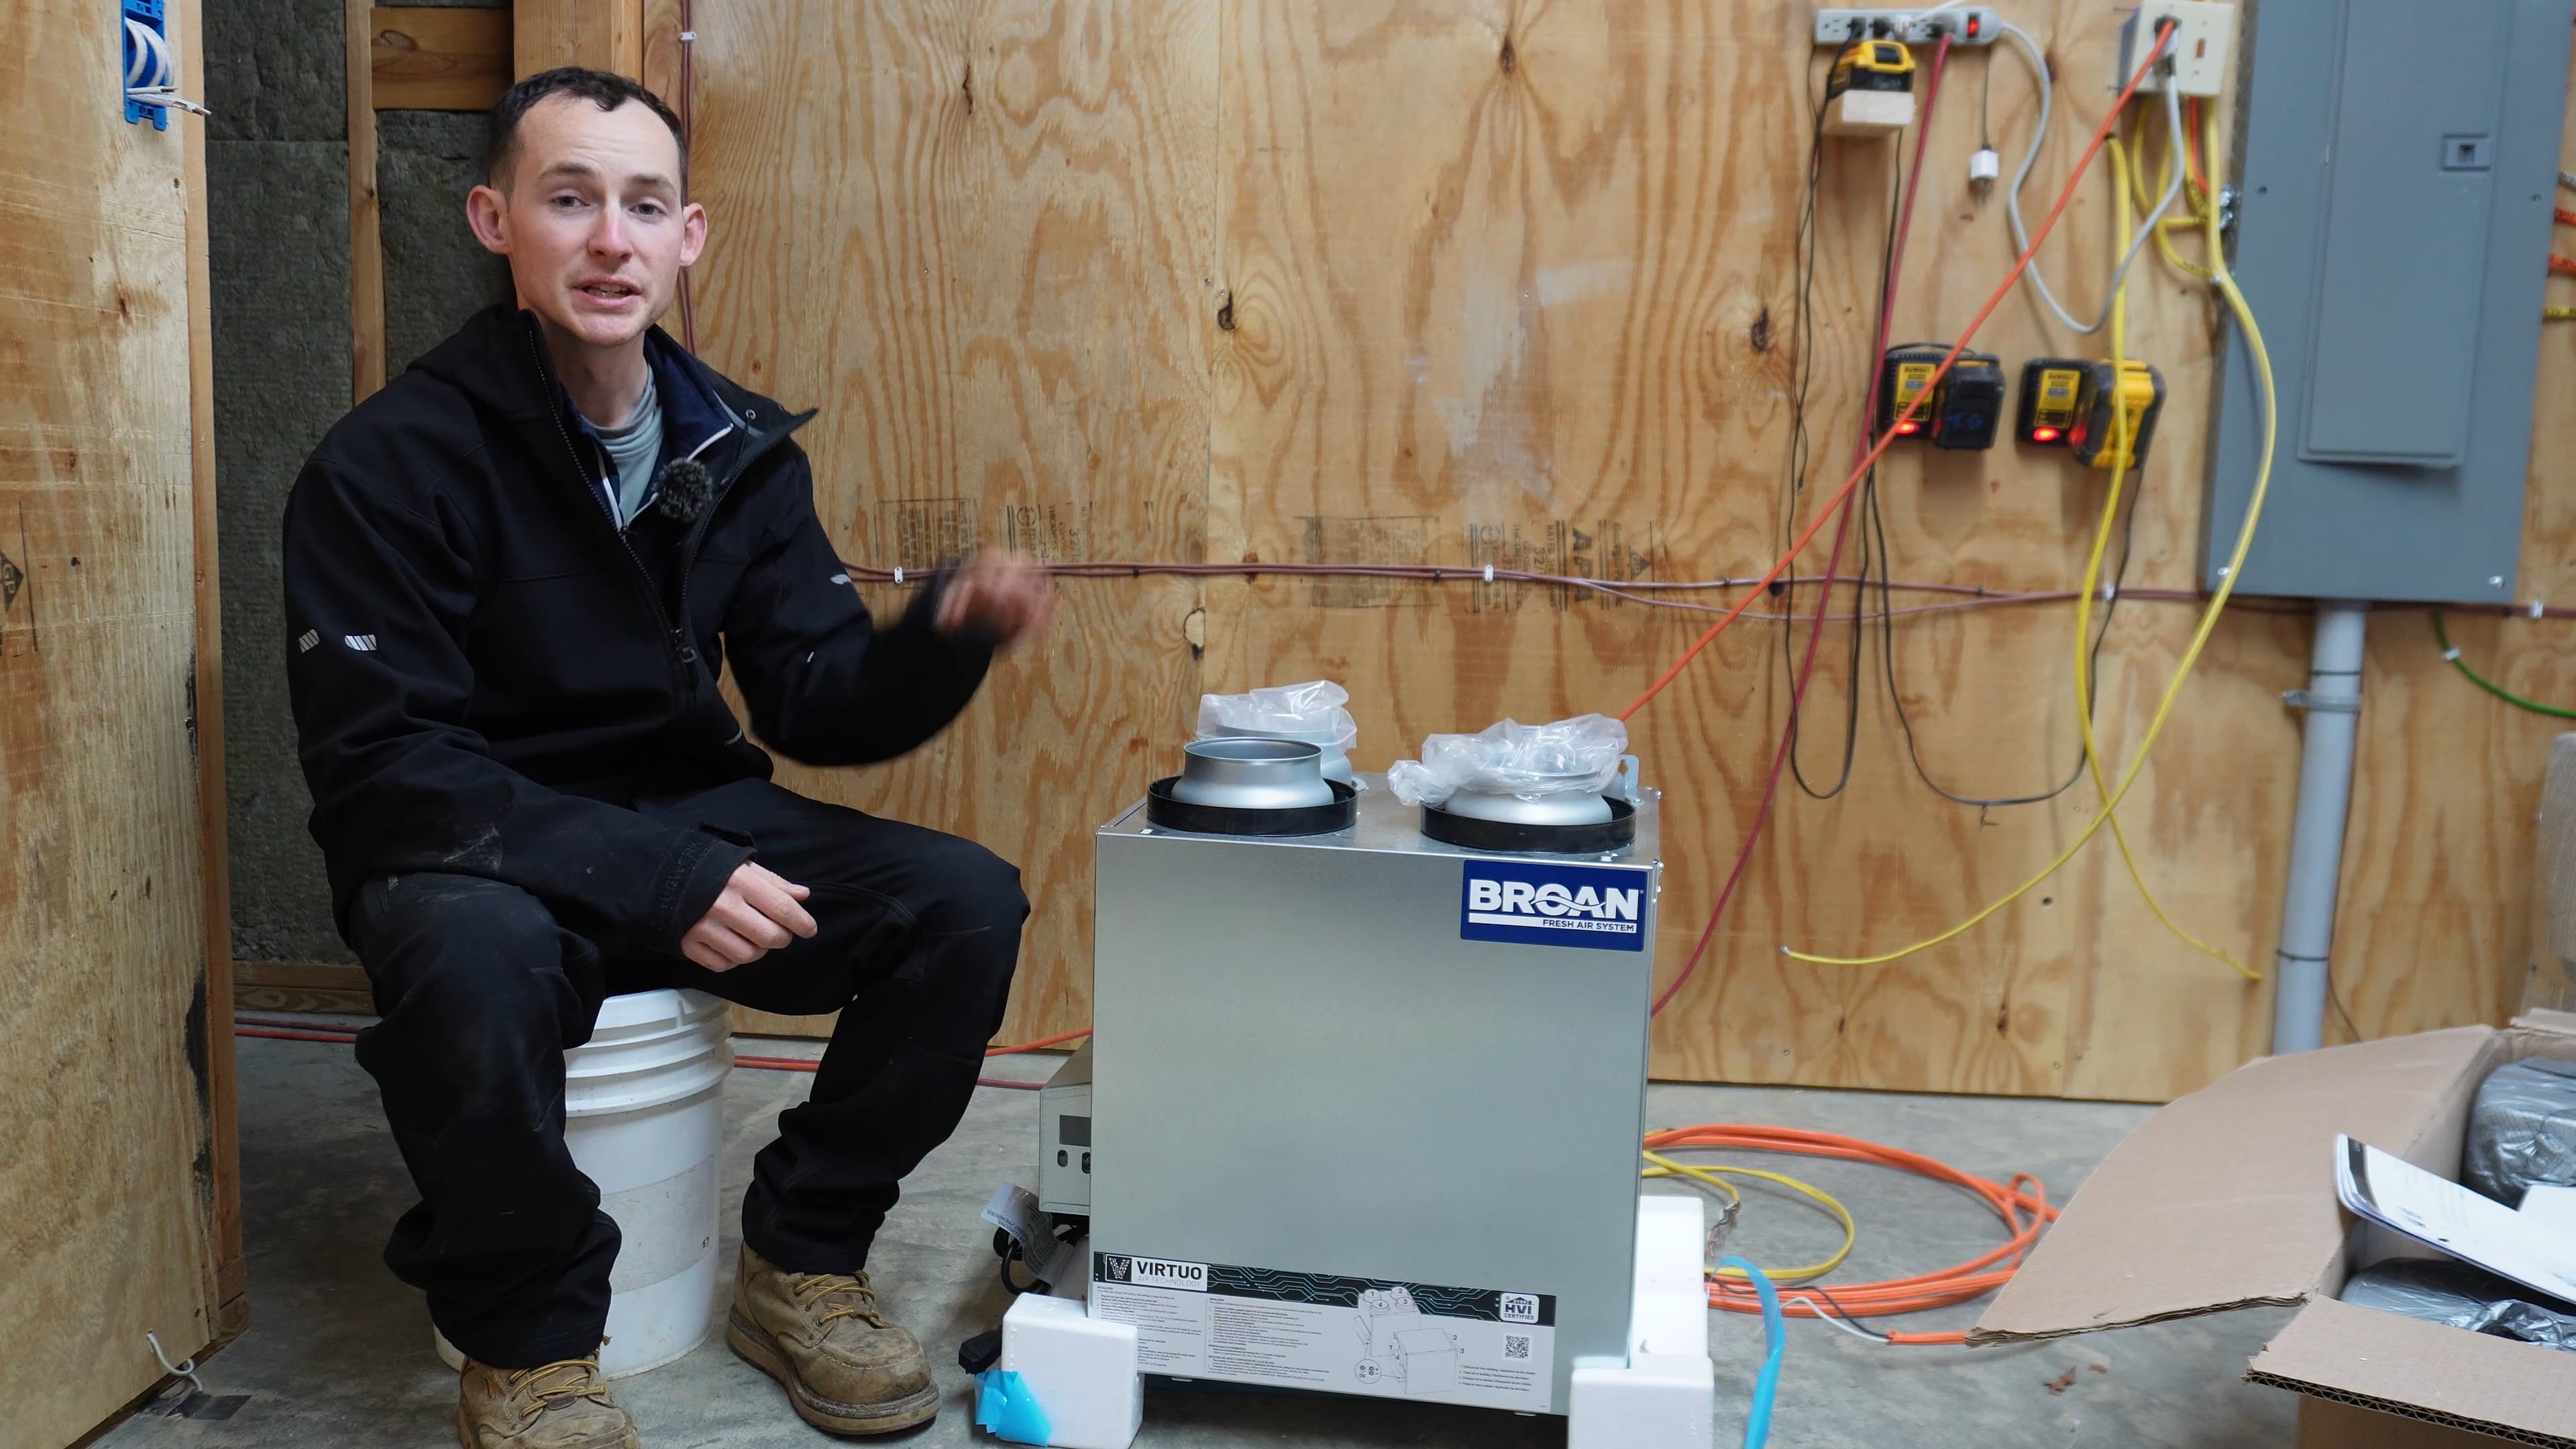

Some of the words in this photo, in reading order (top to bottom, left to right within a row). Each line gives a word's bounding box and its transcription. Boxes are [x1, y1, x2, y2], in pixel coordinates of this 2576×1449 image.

[1631, 555, 1641, 575] GP
[3, 563, 16, 594] GP
[1469, 879, 1640, 920] BROAN
[1543, 919, 1574, 928] FRESH
[1576, 921, 1593, 929] AIR
[1597, 922, 1634, 932] SYSTEM
[1137, 1260, 1202, 1280] VIRTUO
[1152, 1277, 1201, 1288] TECHNOLOGY
[1504, 1312, 1535, 1320] CERTIFIED
[1505, 1303, 1532, 1315] HVI
